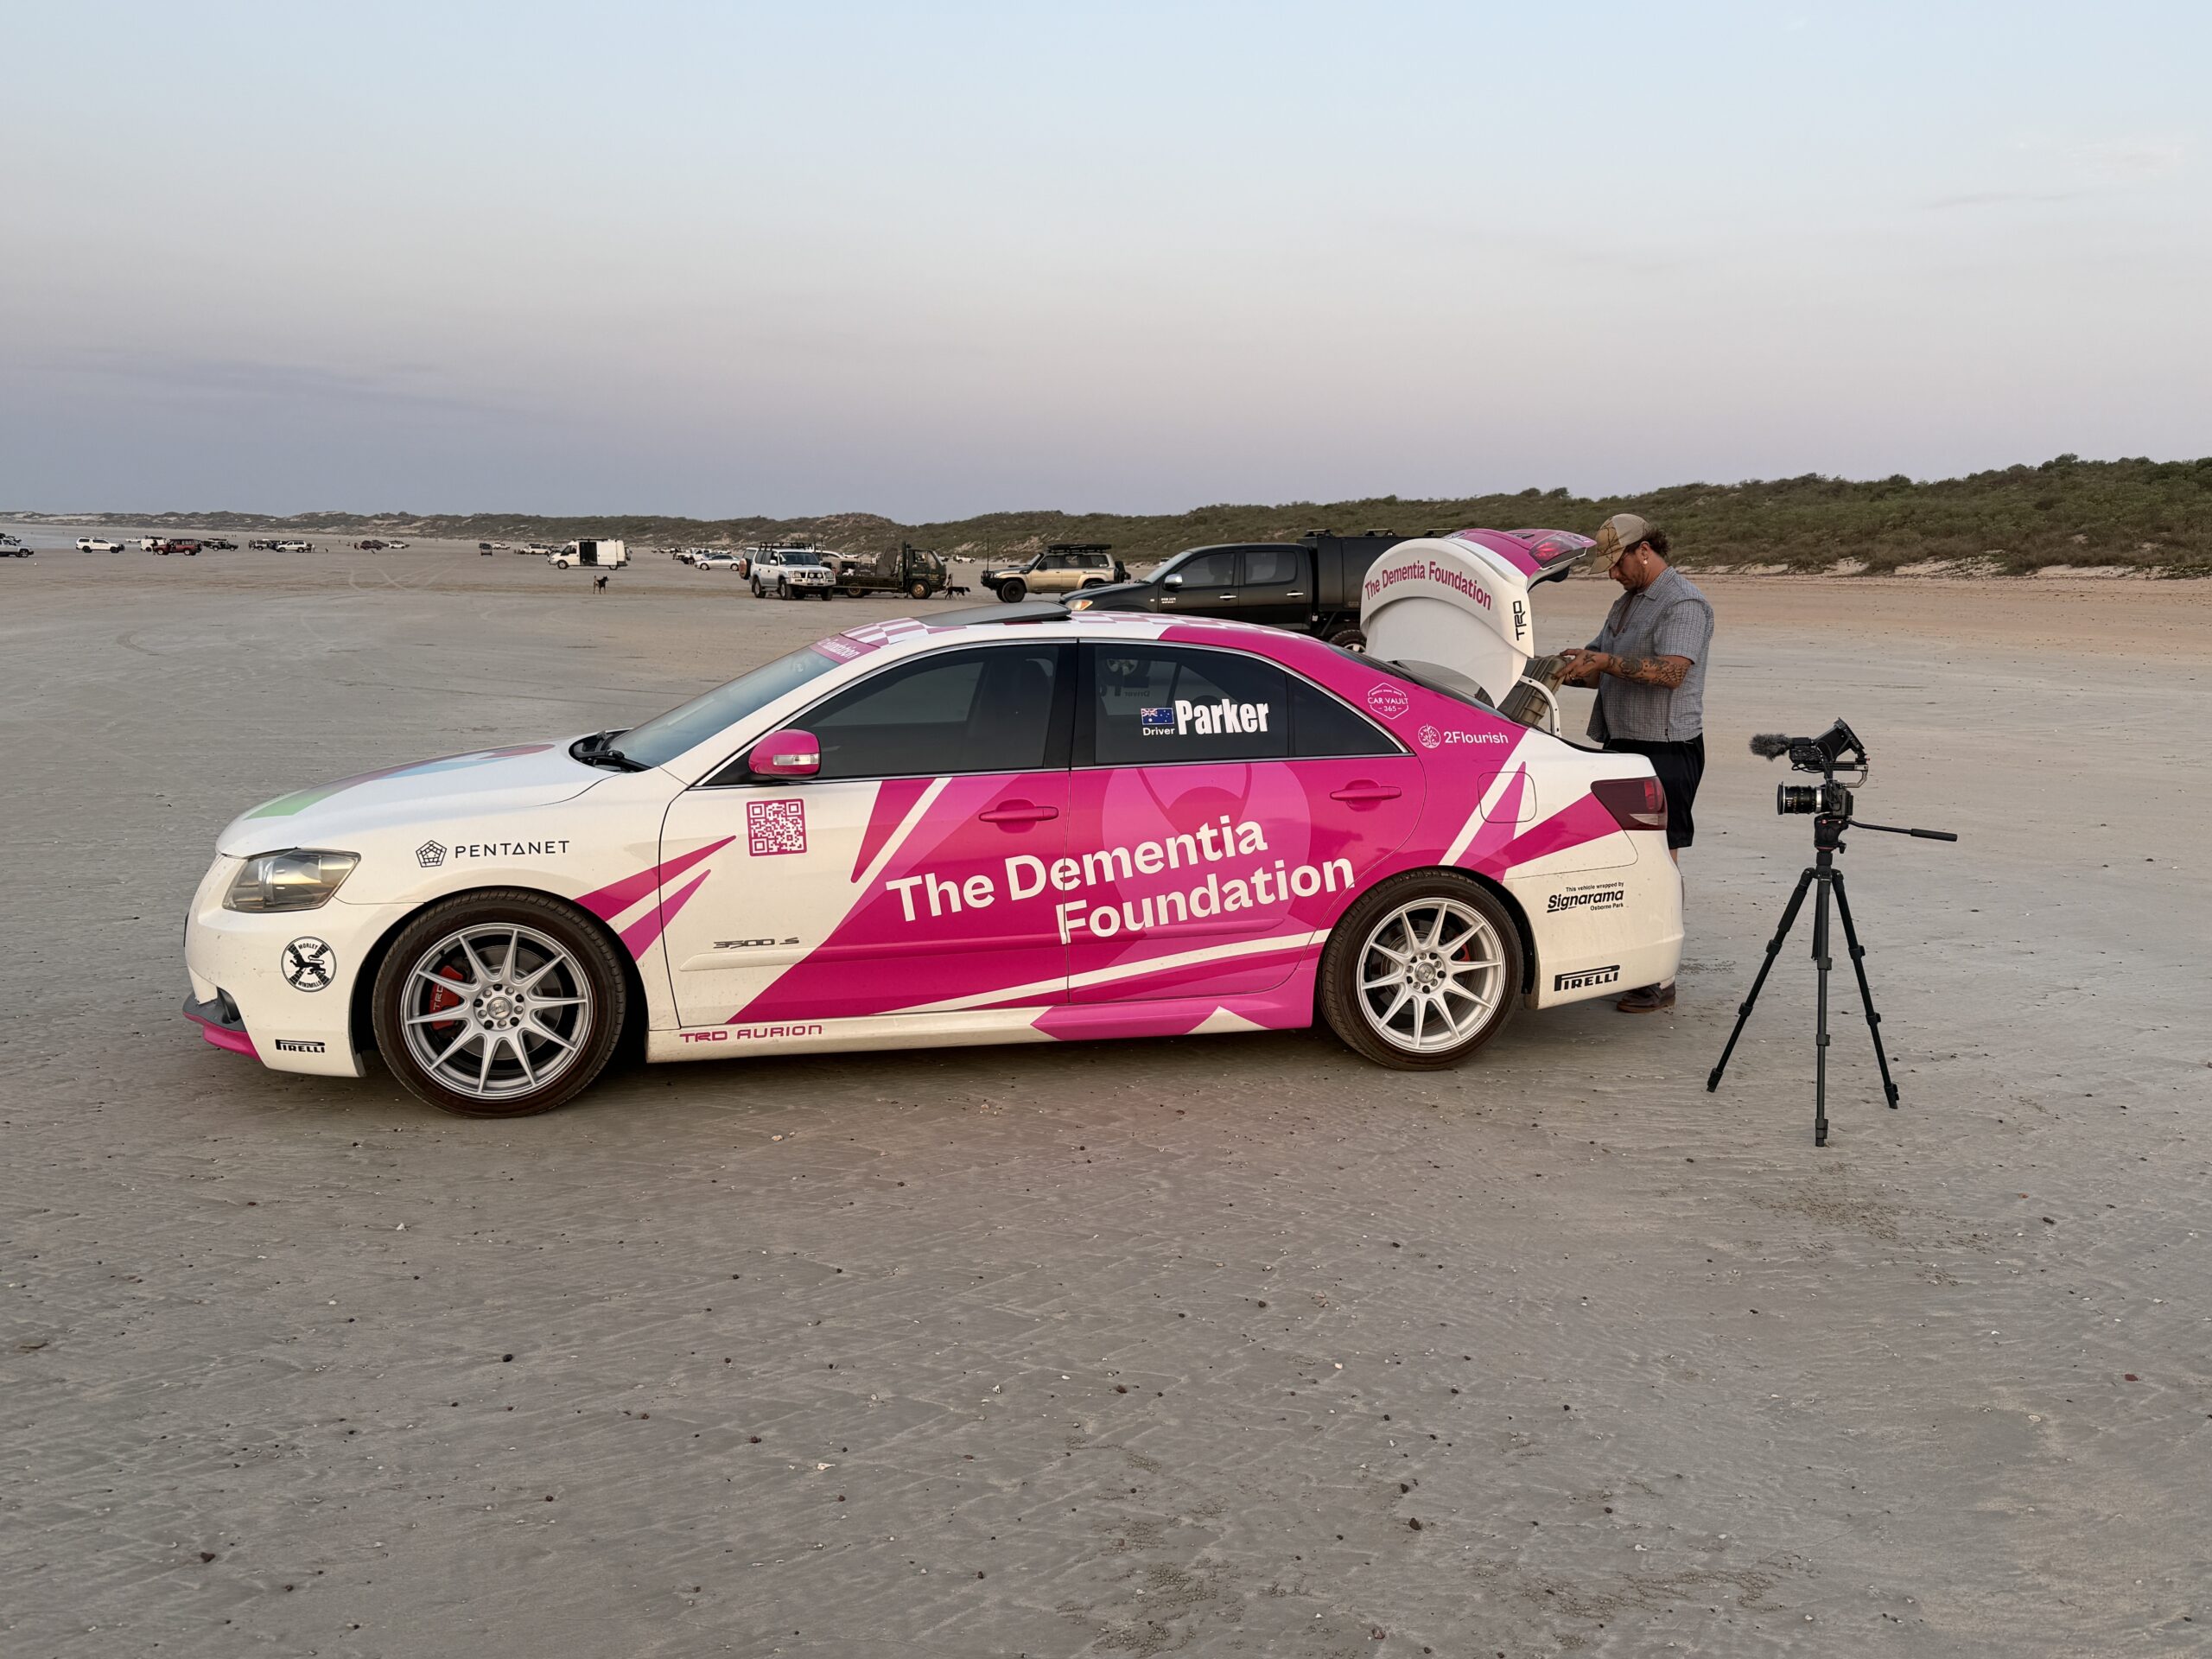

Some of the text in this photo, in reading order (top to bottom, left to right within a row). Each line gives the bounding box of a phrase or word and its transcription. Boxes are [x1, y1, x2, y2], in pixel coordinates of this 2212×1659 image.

[1364, 560, 1491, 610] The Dementia Foundation
[1512, 600, 1527, 641] TRD
[1142, 698, 1269, 736] Driver Parker
[1443, 731, 1509, 744] 2Flourish
[454, 840, 570, 859] PENTANET
[886, 814, 1268, 922] The Dementia
[1055, 856, 1355, 945] Foundation
[1548, 889, 1624, 912] Signarama
[713, 938, 775, 949] 3500
[1554, 965, 1620, 991] PIRELLI
[275, 1039, 325, 1052] PIRELLI
[679, 1025, 823, 1043] TRD AURION
